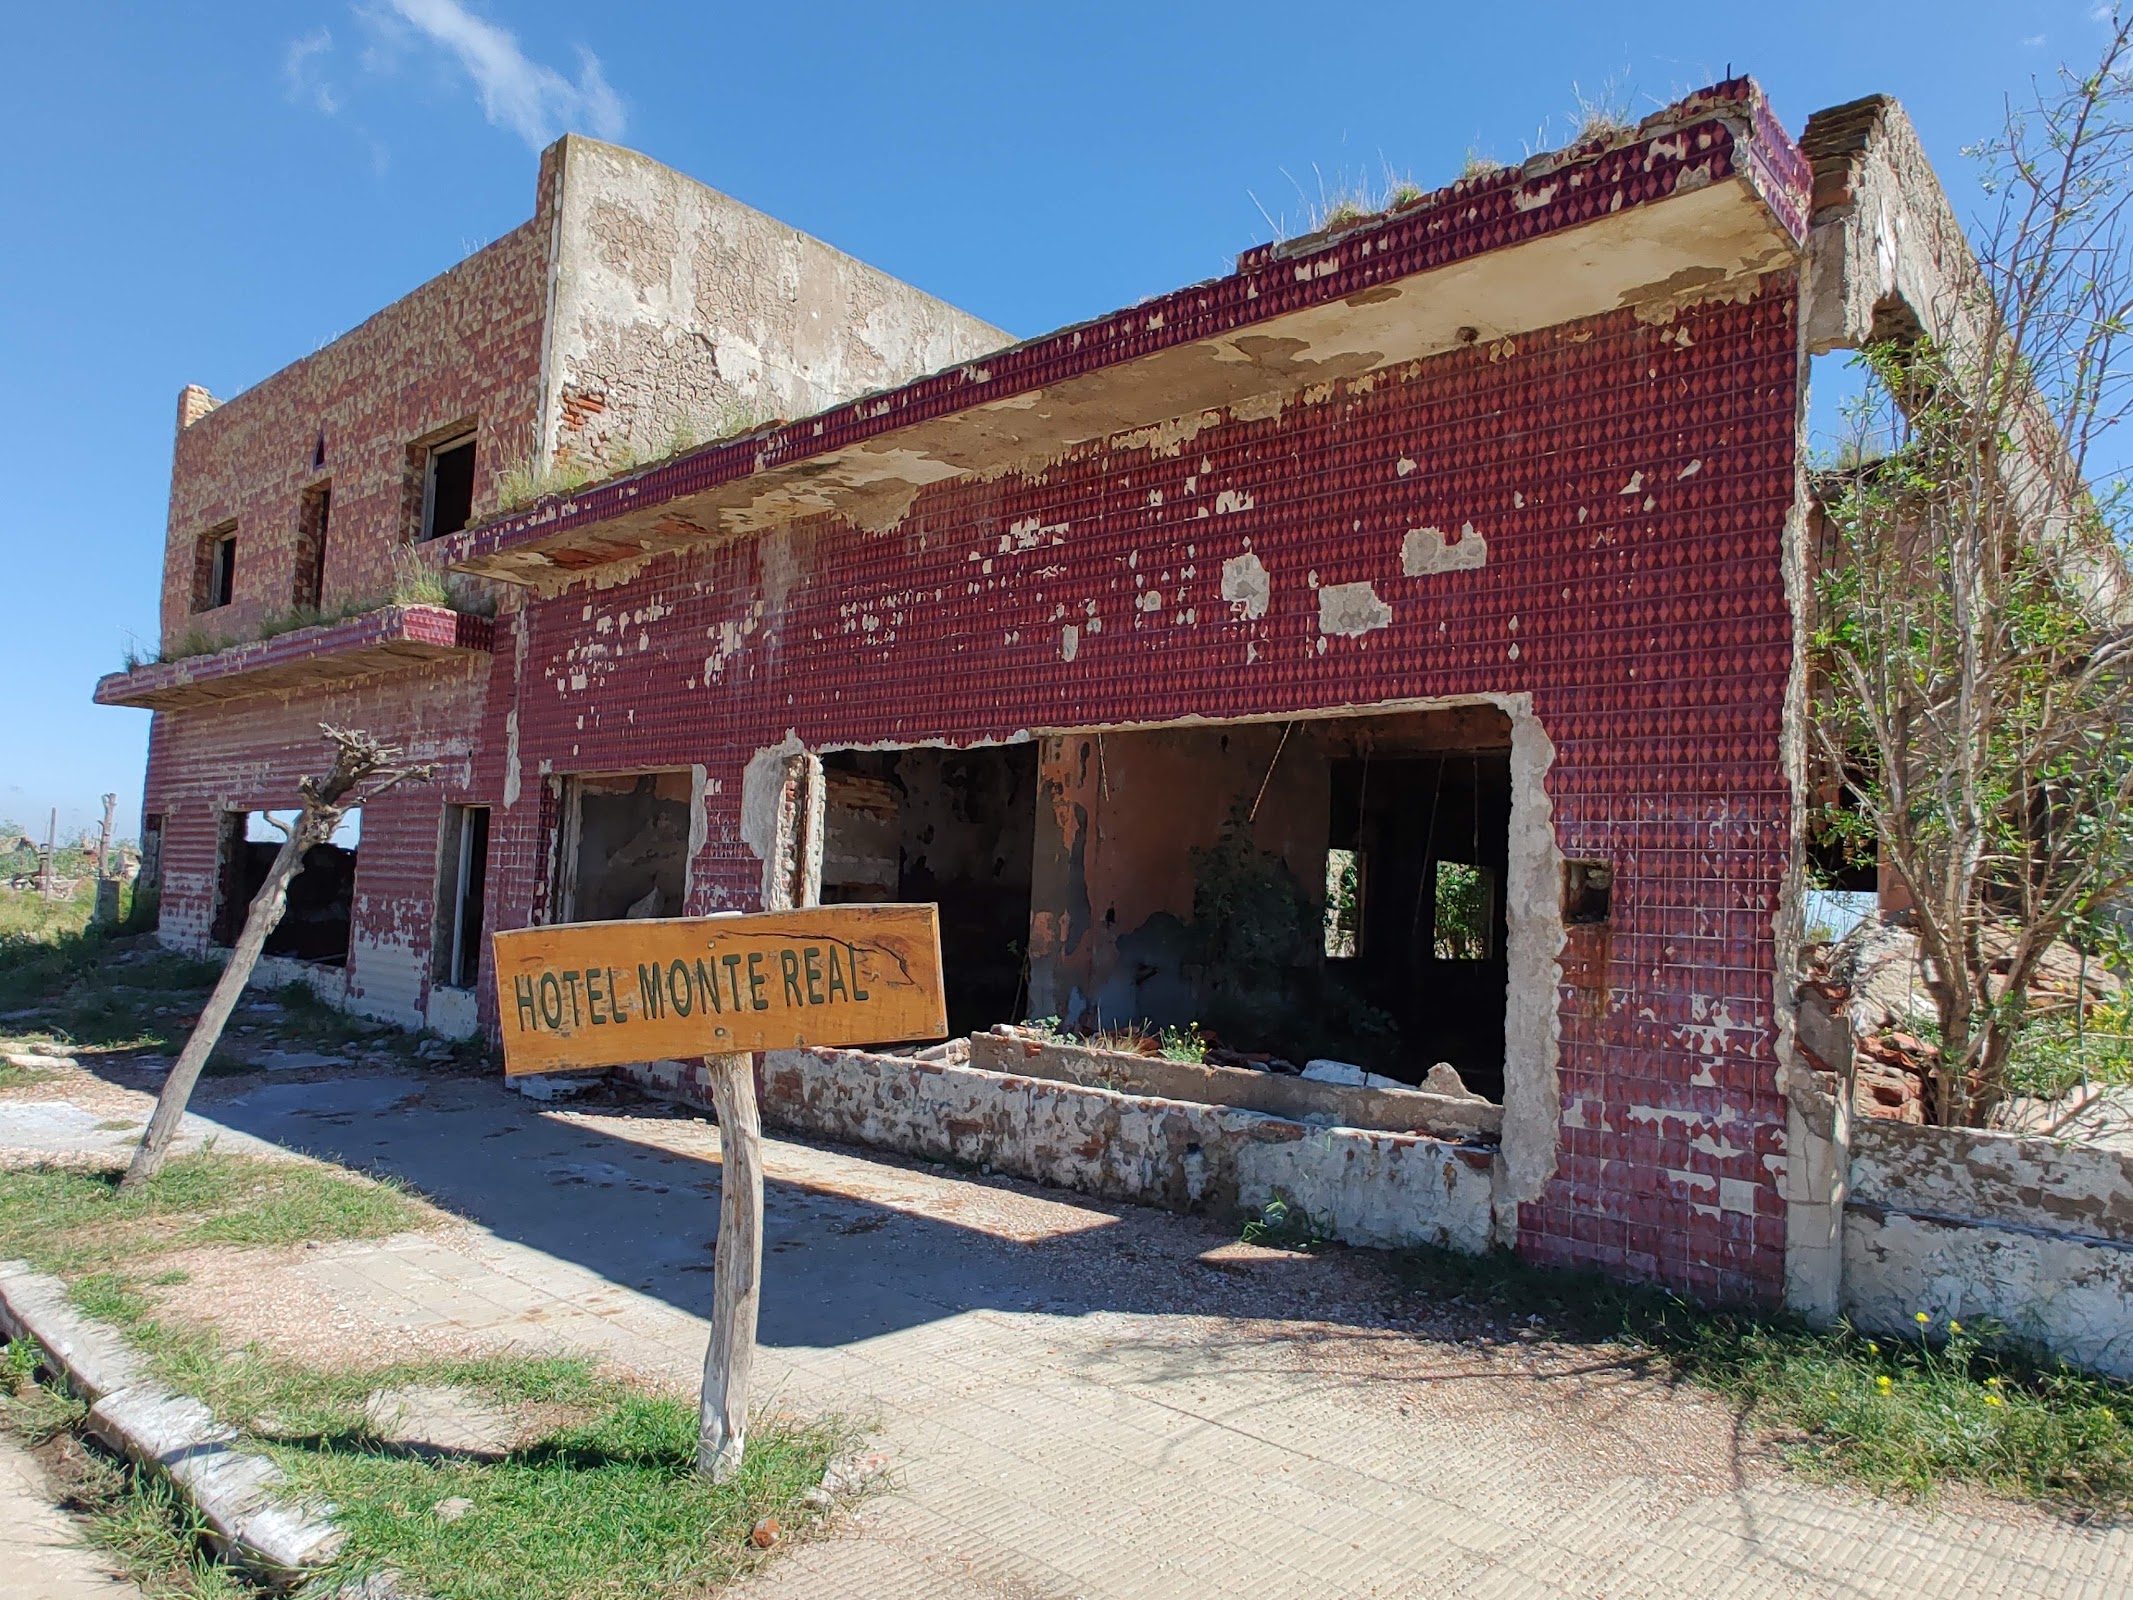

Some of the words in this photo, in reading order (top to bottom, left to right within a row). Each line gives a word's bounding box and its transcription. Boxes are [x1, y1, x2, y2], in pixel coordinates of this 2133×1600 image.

[514, 966, 628, 1032] HOTEL
[638, 952, 769, 1020] MONTE
[781, 941, 869, 1007] REAL
